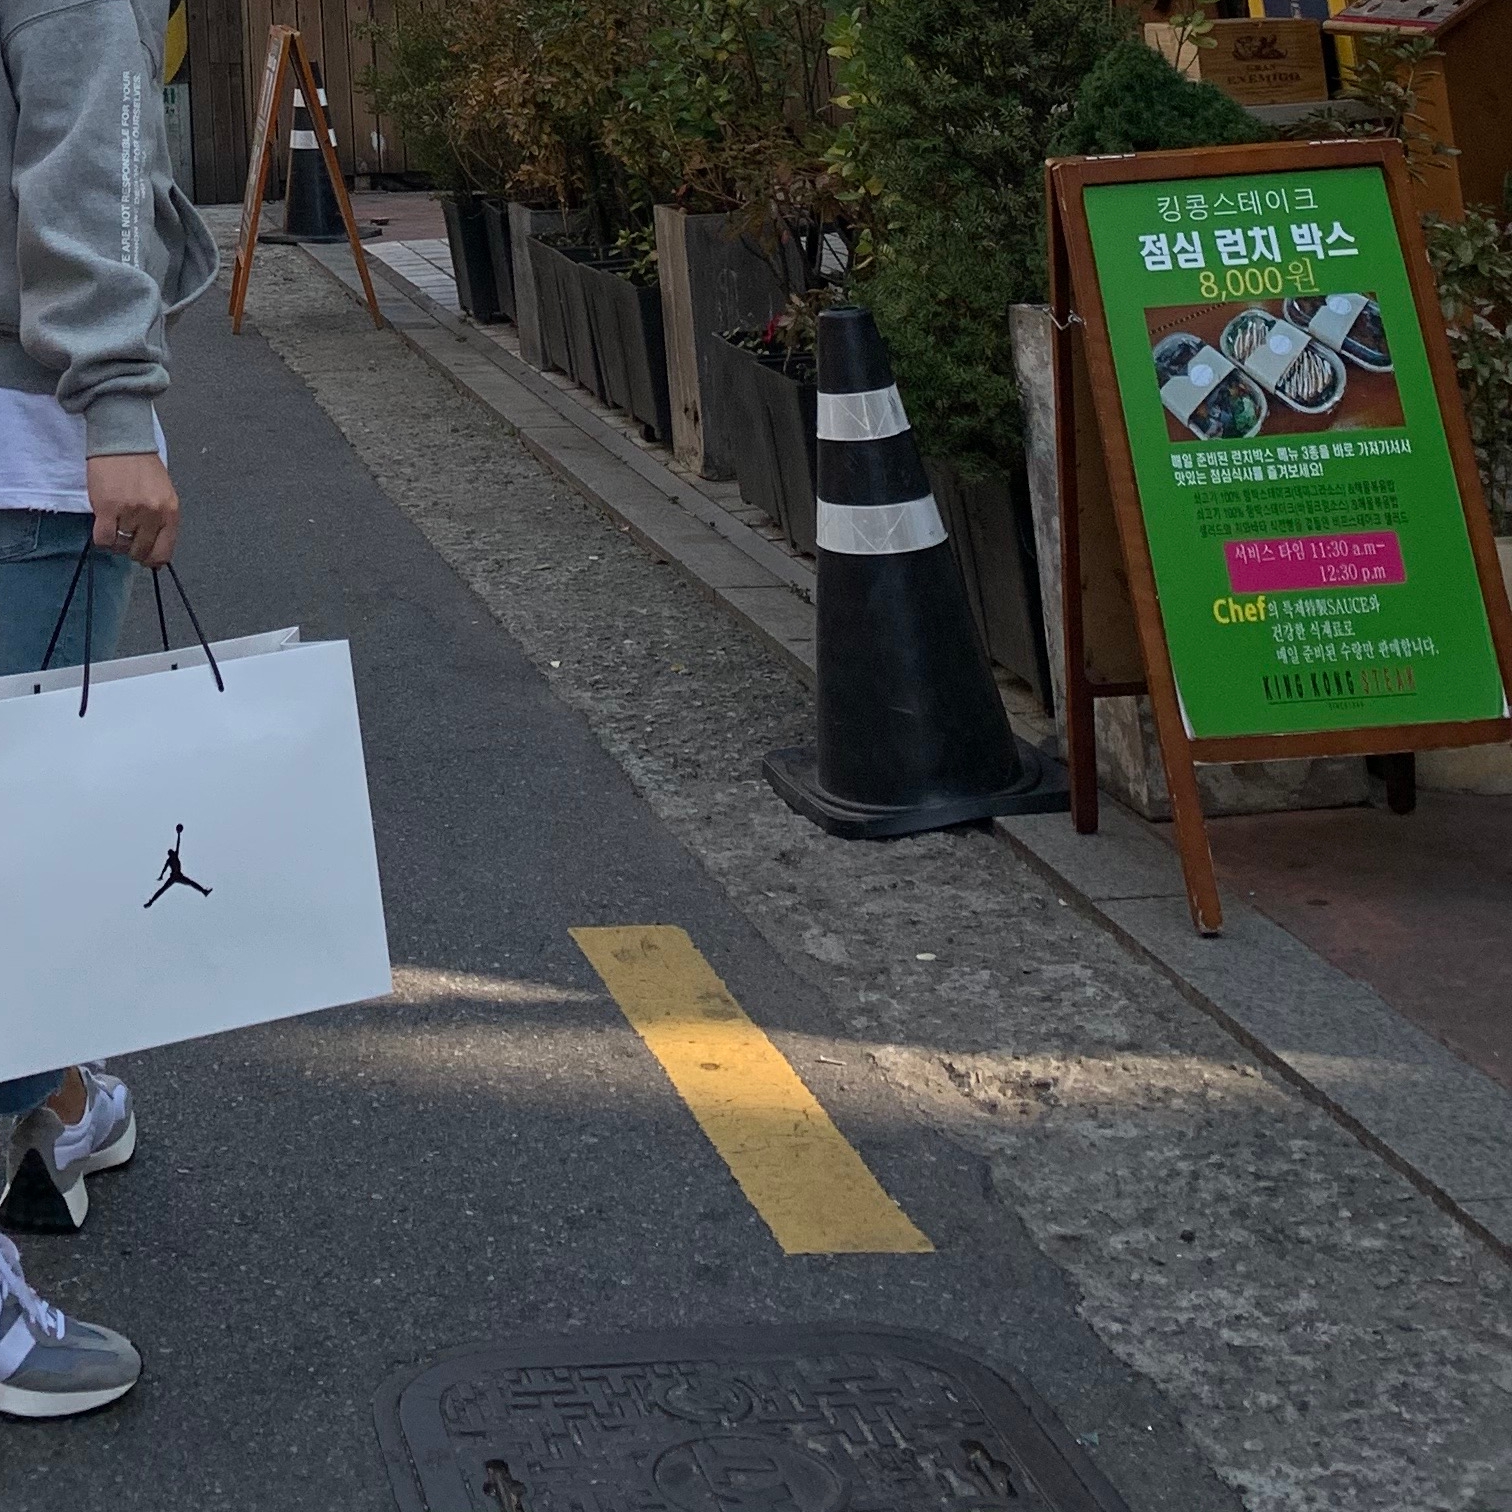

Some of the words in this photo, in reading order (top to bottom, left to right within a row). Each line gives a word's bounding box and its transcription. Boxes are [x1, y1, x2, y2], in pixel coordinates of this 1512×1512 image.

[122, 71, 130, 102] YOUR
[121, 105, 130, 127] FOR
[121, 128, 131, 203] RESPONSIBLE
[121, 204, 131, 228] NOT
[1157, 188, 1319, 222] 킹콩스테이크
[121, 230, 131, 252] ARE
[1138, 230, 1206, 271] 점심
[1214, 226, 1282, 266] 런치
[1290, 221, 1359, 259] 박스
[1196, 451, 1229, 468] 준비된
[1231, 448, 1275, 466] 런치박스
[1277, 446, 1299, 462] 메뉴
[1301, 444, 1330, 461] 3종을
[1332, 442, 1355, 458] 바로
[1174, 470, 1207, 486] 맛있는
[1210, 465, 1263, 484] 점심식사를
[1267, 461, 1324, 480] 즐겨보세요!
[1234, 543, 1276, 565] 서비스
[1278, 541, 1305, 561] 타임
[1311, 540, 1348, 559] 11:30
[1319, 564, 1357, 582] 12:30
[1362, 564, 1387, 582] p.m
[1272, 623, 1306, 644] 건강한
[1309, 620, 1356, 640] 식재료로
[1276, 644, 1300, 665] 매일
[1303, 643, 1338, 664] 준비된
[1340, 640, 1375, 661] 수량만
[1262, 673, 1304, 700] KING
[1310, 669, 1355, 695] KONG
[1360, 665, 1416, 695] STEAK
